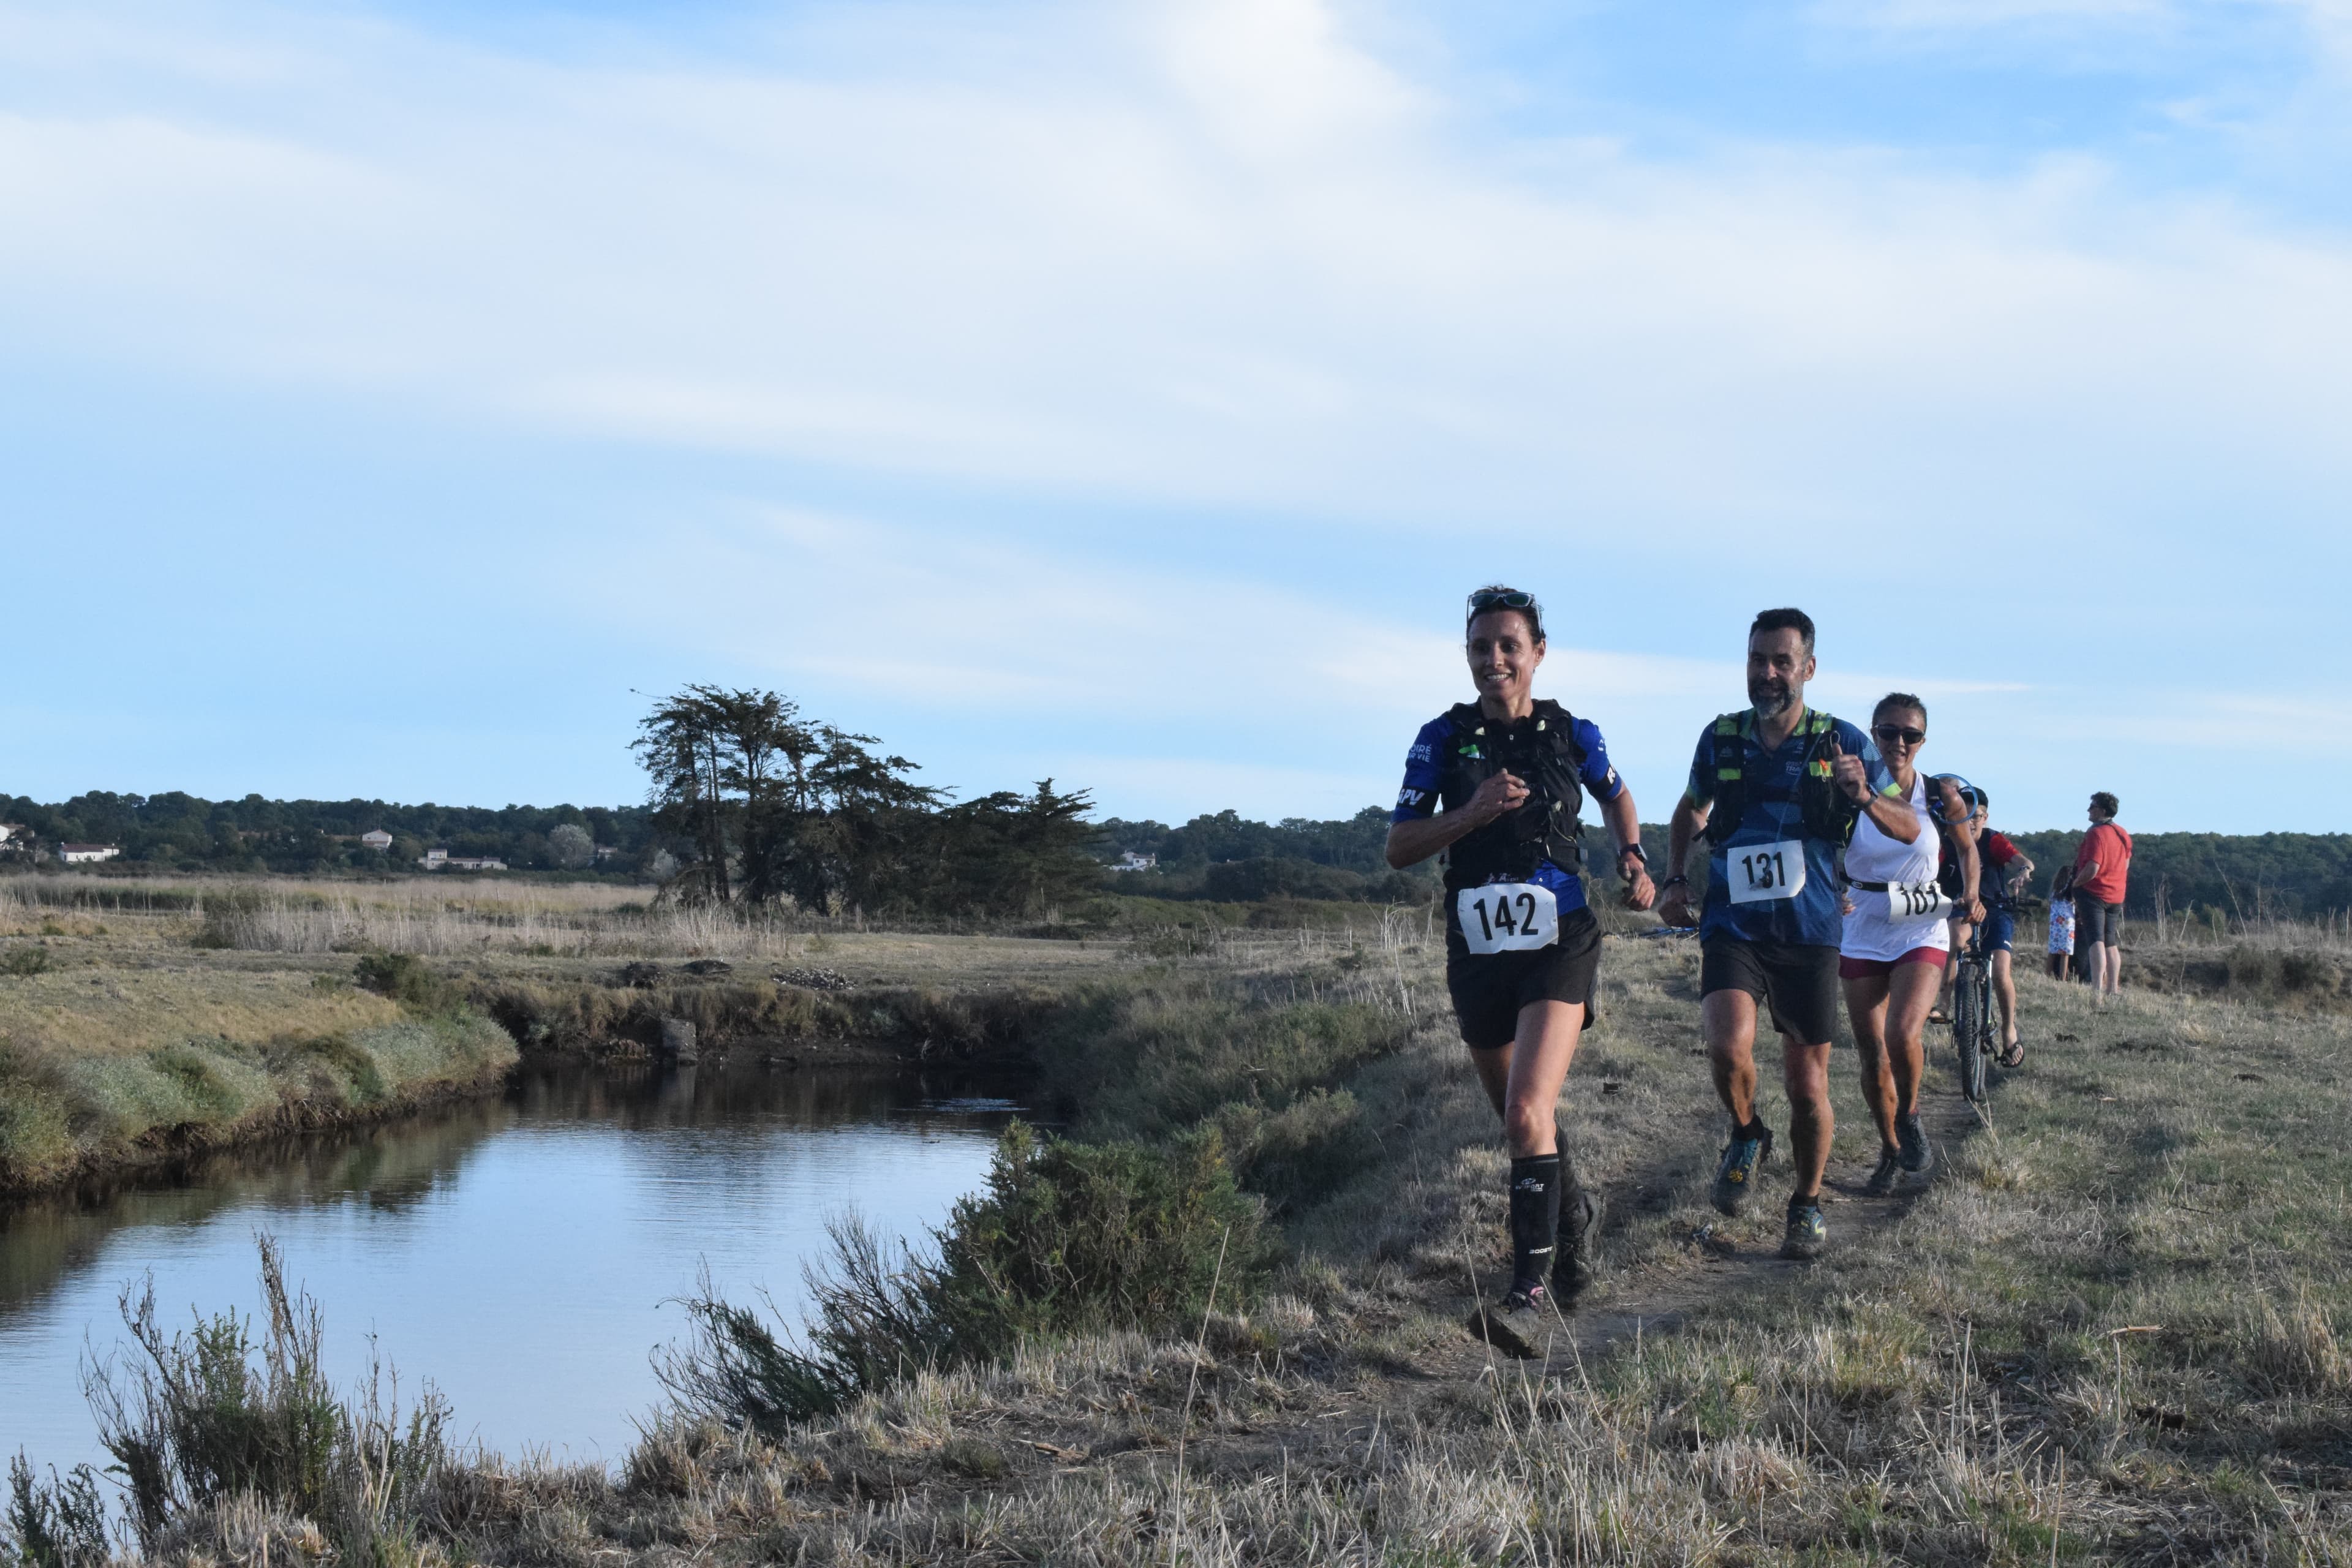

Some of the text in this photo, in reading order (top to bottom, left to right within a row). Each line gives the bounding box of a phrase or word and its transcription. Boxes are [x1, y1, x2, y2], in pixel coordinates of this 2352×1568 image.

[1409, 744, 1431, 755] OIRÉ
[1417, 754, 1430, 763] VIE
[1741, 851, 1785, 889] 131
[1472, 892, 1539, 941] 142
